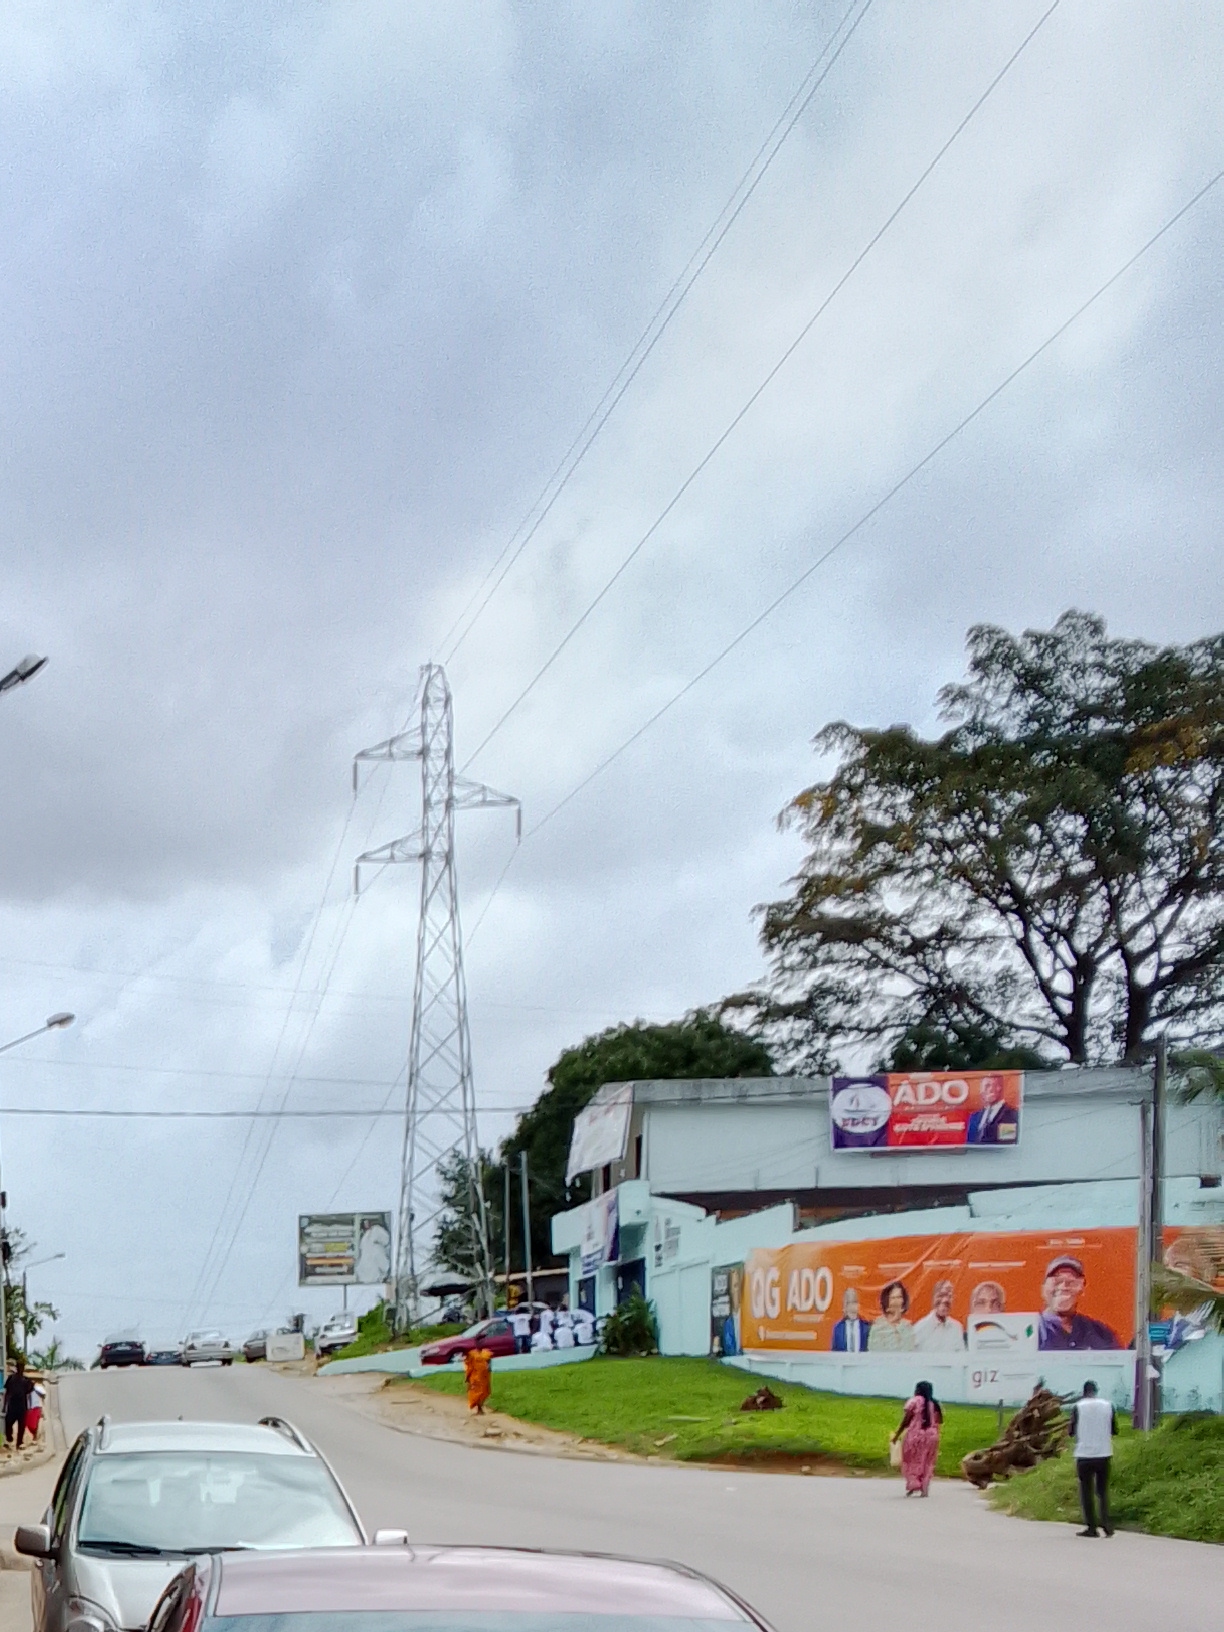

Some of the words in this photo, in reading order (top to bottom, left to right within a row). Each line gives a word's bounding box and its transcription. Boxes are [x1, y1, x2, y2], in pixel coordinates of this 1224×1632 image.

[893, 1079, 969, 1107] ADO
[786, 1266, 833, 1313] ADO
[972, 1369, 999, 1388] giz
